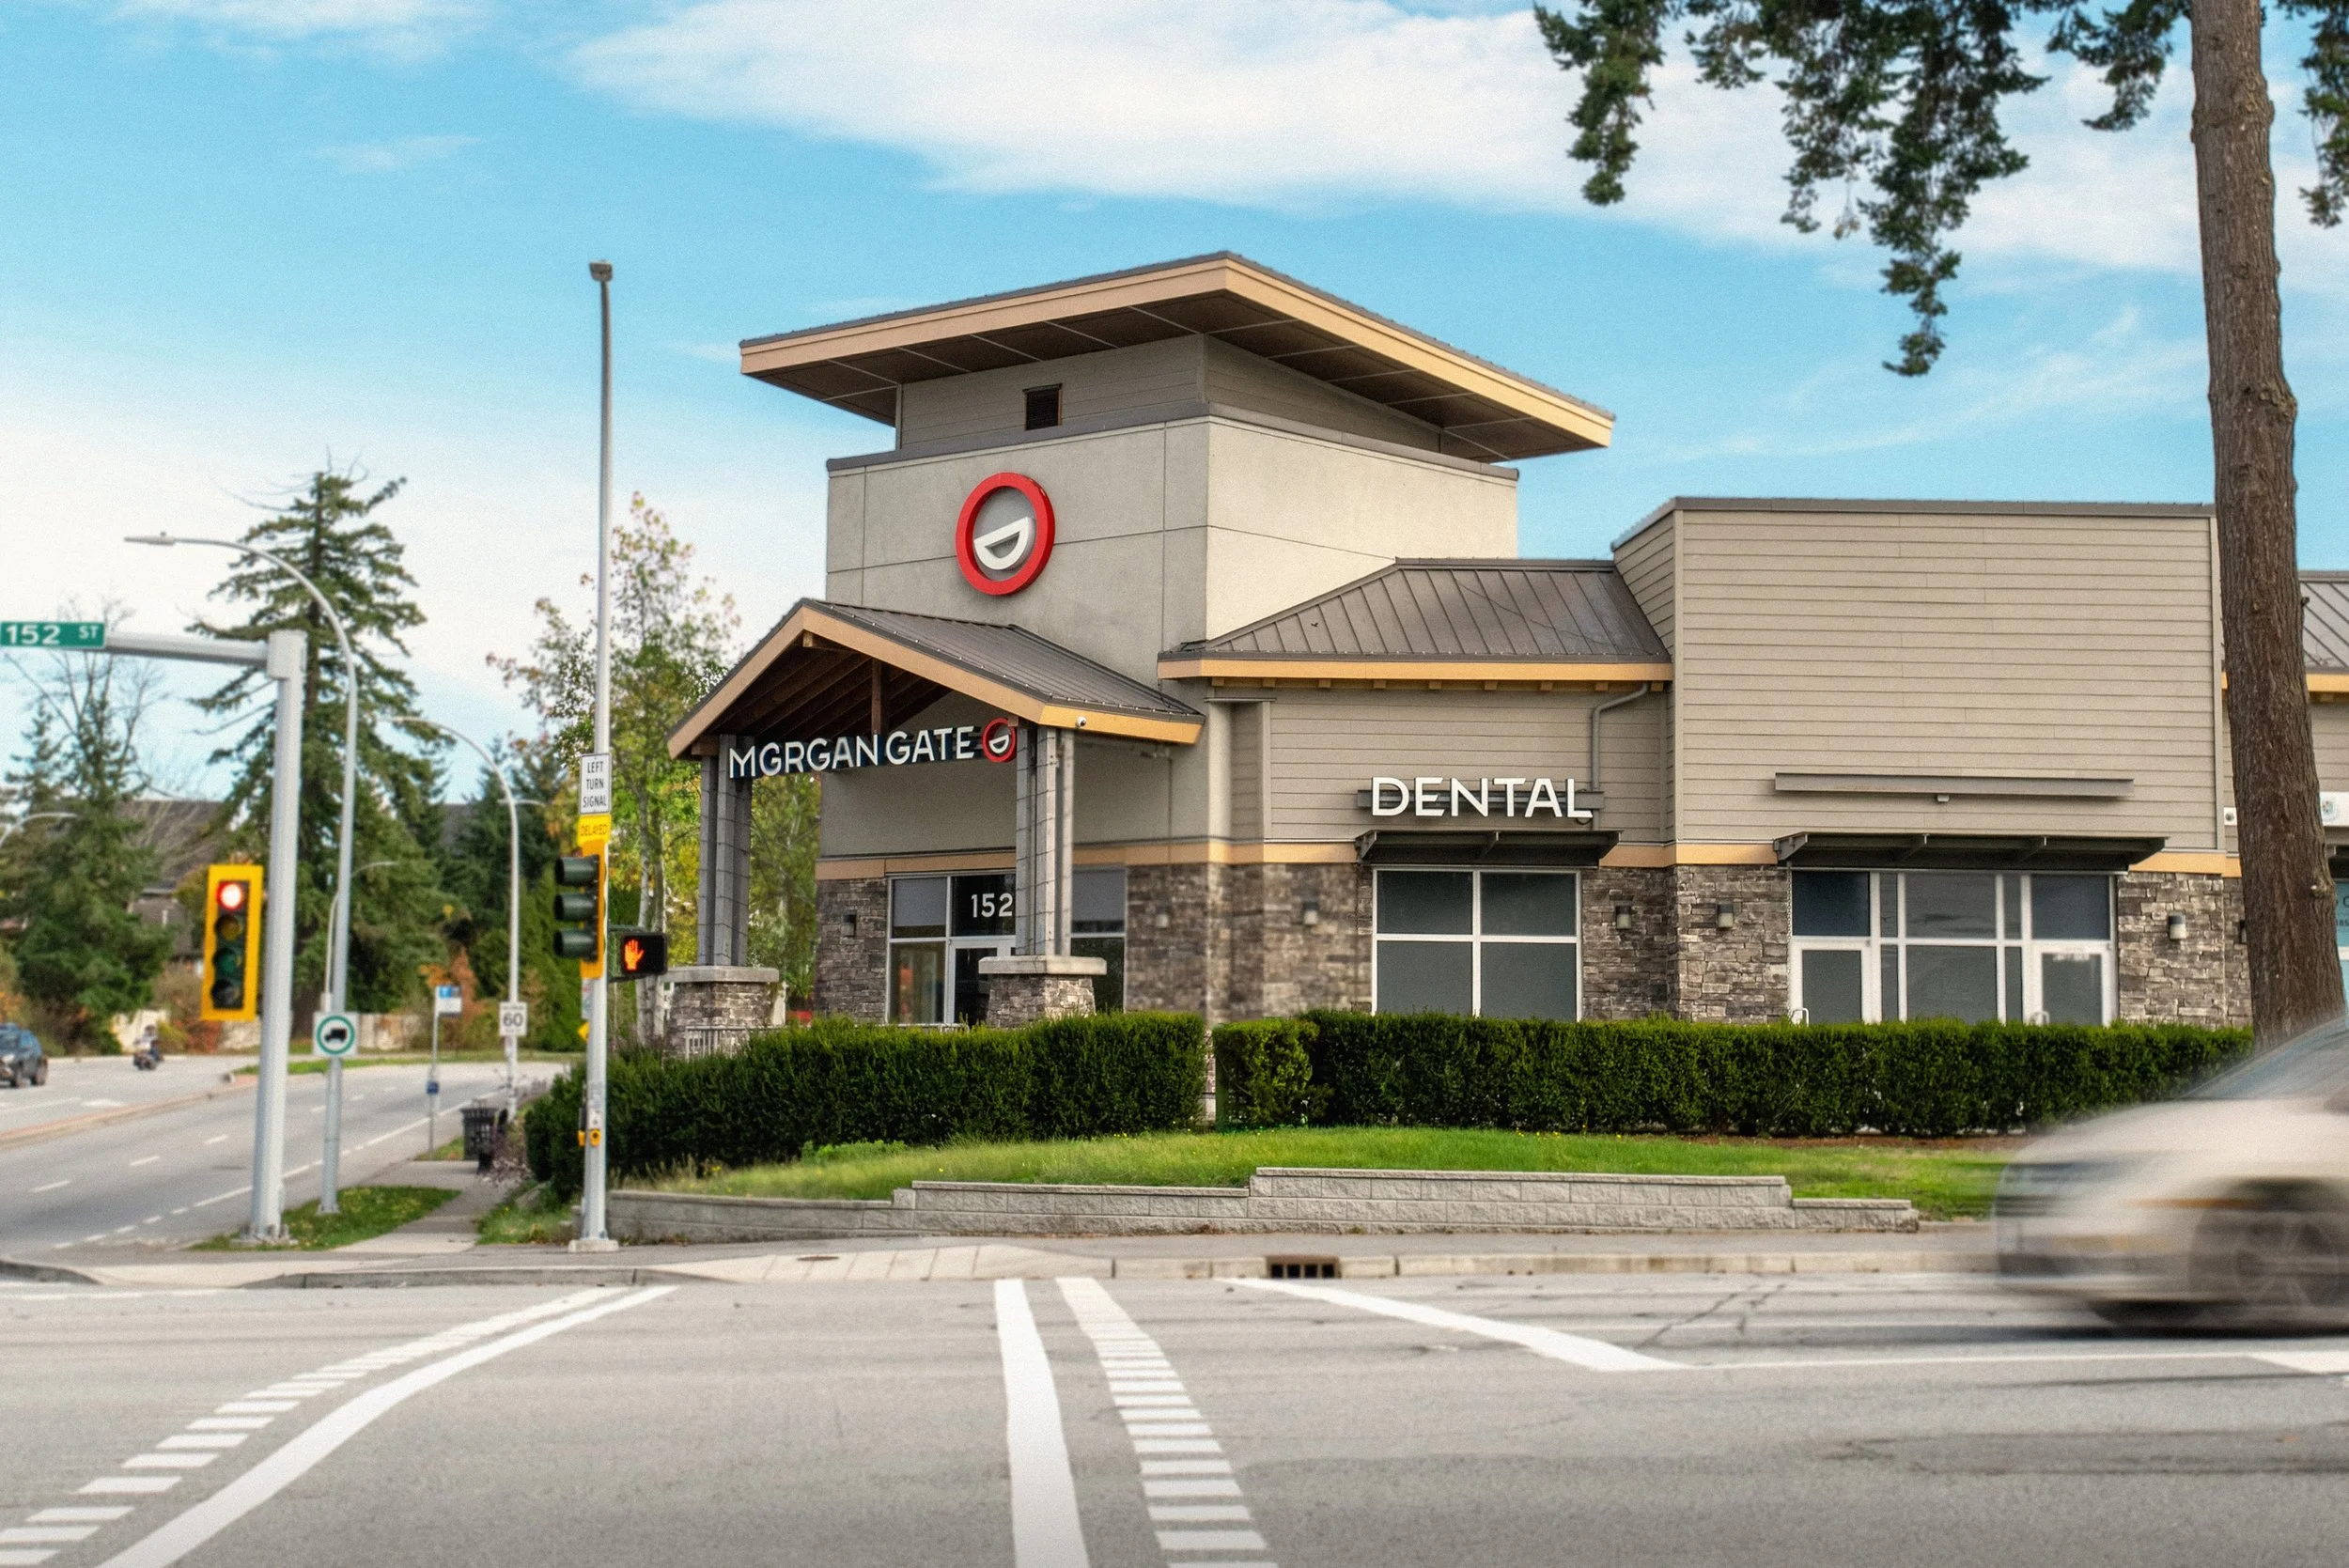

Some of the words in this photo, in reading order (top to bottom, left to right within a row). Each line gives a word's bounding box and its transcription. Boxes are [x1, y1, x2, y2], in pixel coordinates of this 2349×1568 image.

[6, 624, 61, 645] 152
[78, 625, 100, 640] ST
[885, 725, 975, 766] GATE
[587, 761, 603, 774] LEFT
[585, 777, 604, 790] TURN
[583, 795, 607, 808] SIGNAL
[1371, 776, 1594, 818] DENTAL
[971, 892, 1014, 918] 152
[503, 1012, 523, 1027] 60
